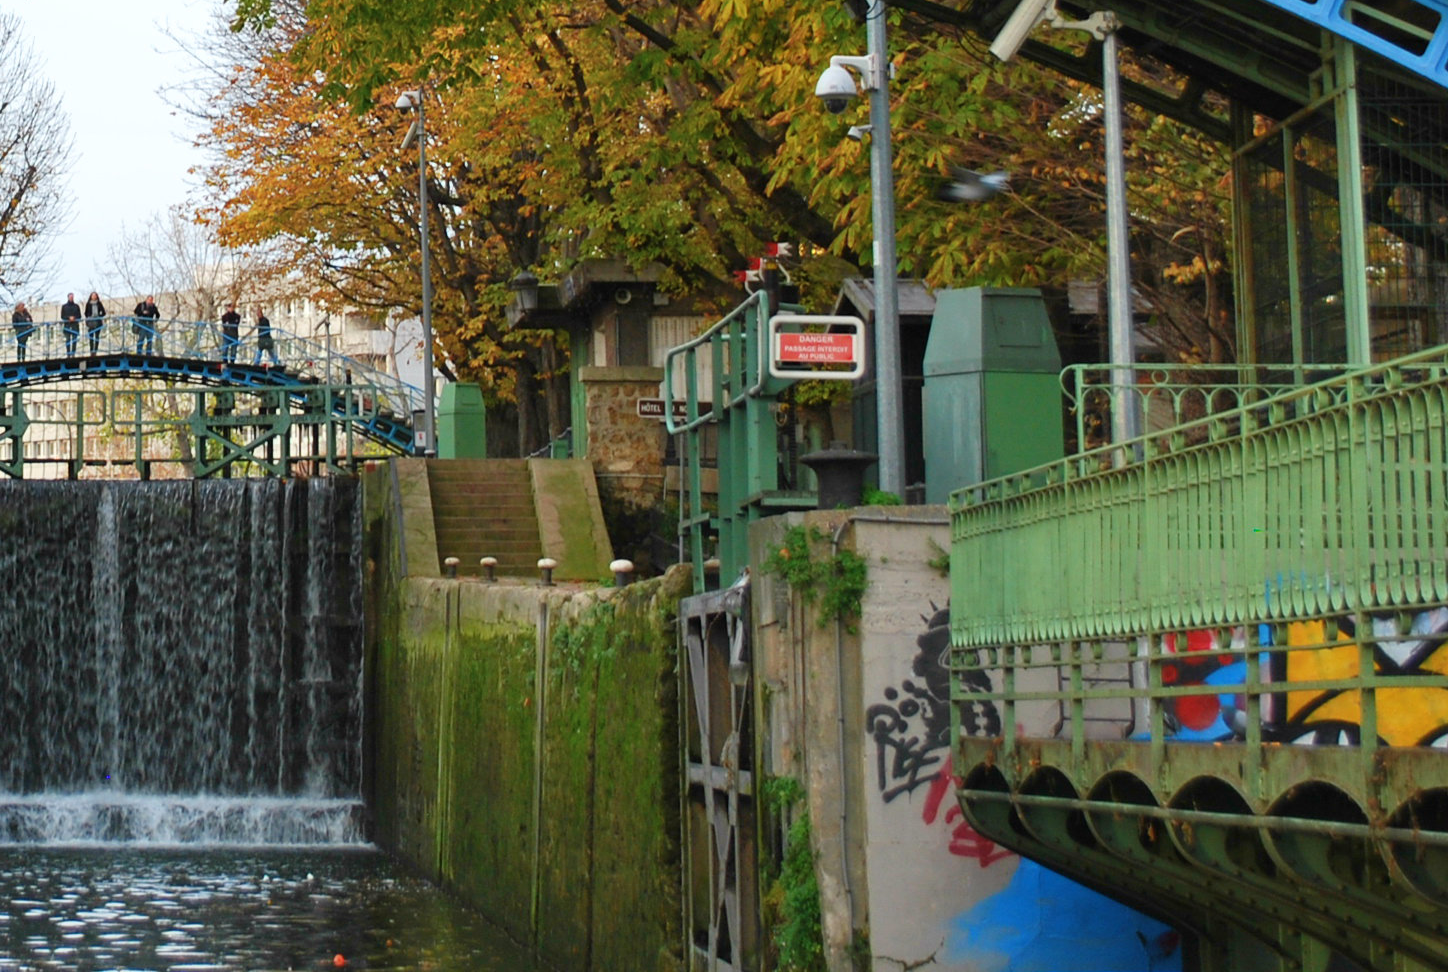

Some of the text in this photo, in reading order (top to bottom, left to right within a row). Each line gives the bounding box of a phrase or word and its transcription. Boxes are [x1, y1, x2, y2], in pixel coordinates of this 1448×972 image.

[799, 335, 833, 343] DANGER
[784, 345, 816, 353] PASSAGE
[641, 402, 662, 413] HÔTEL
